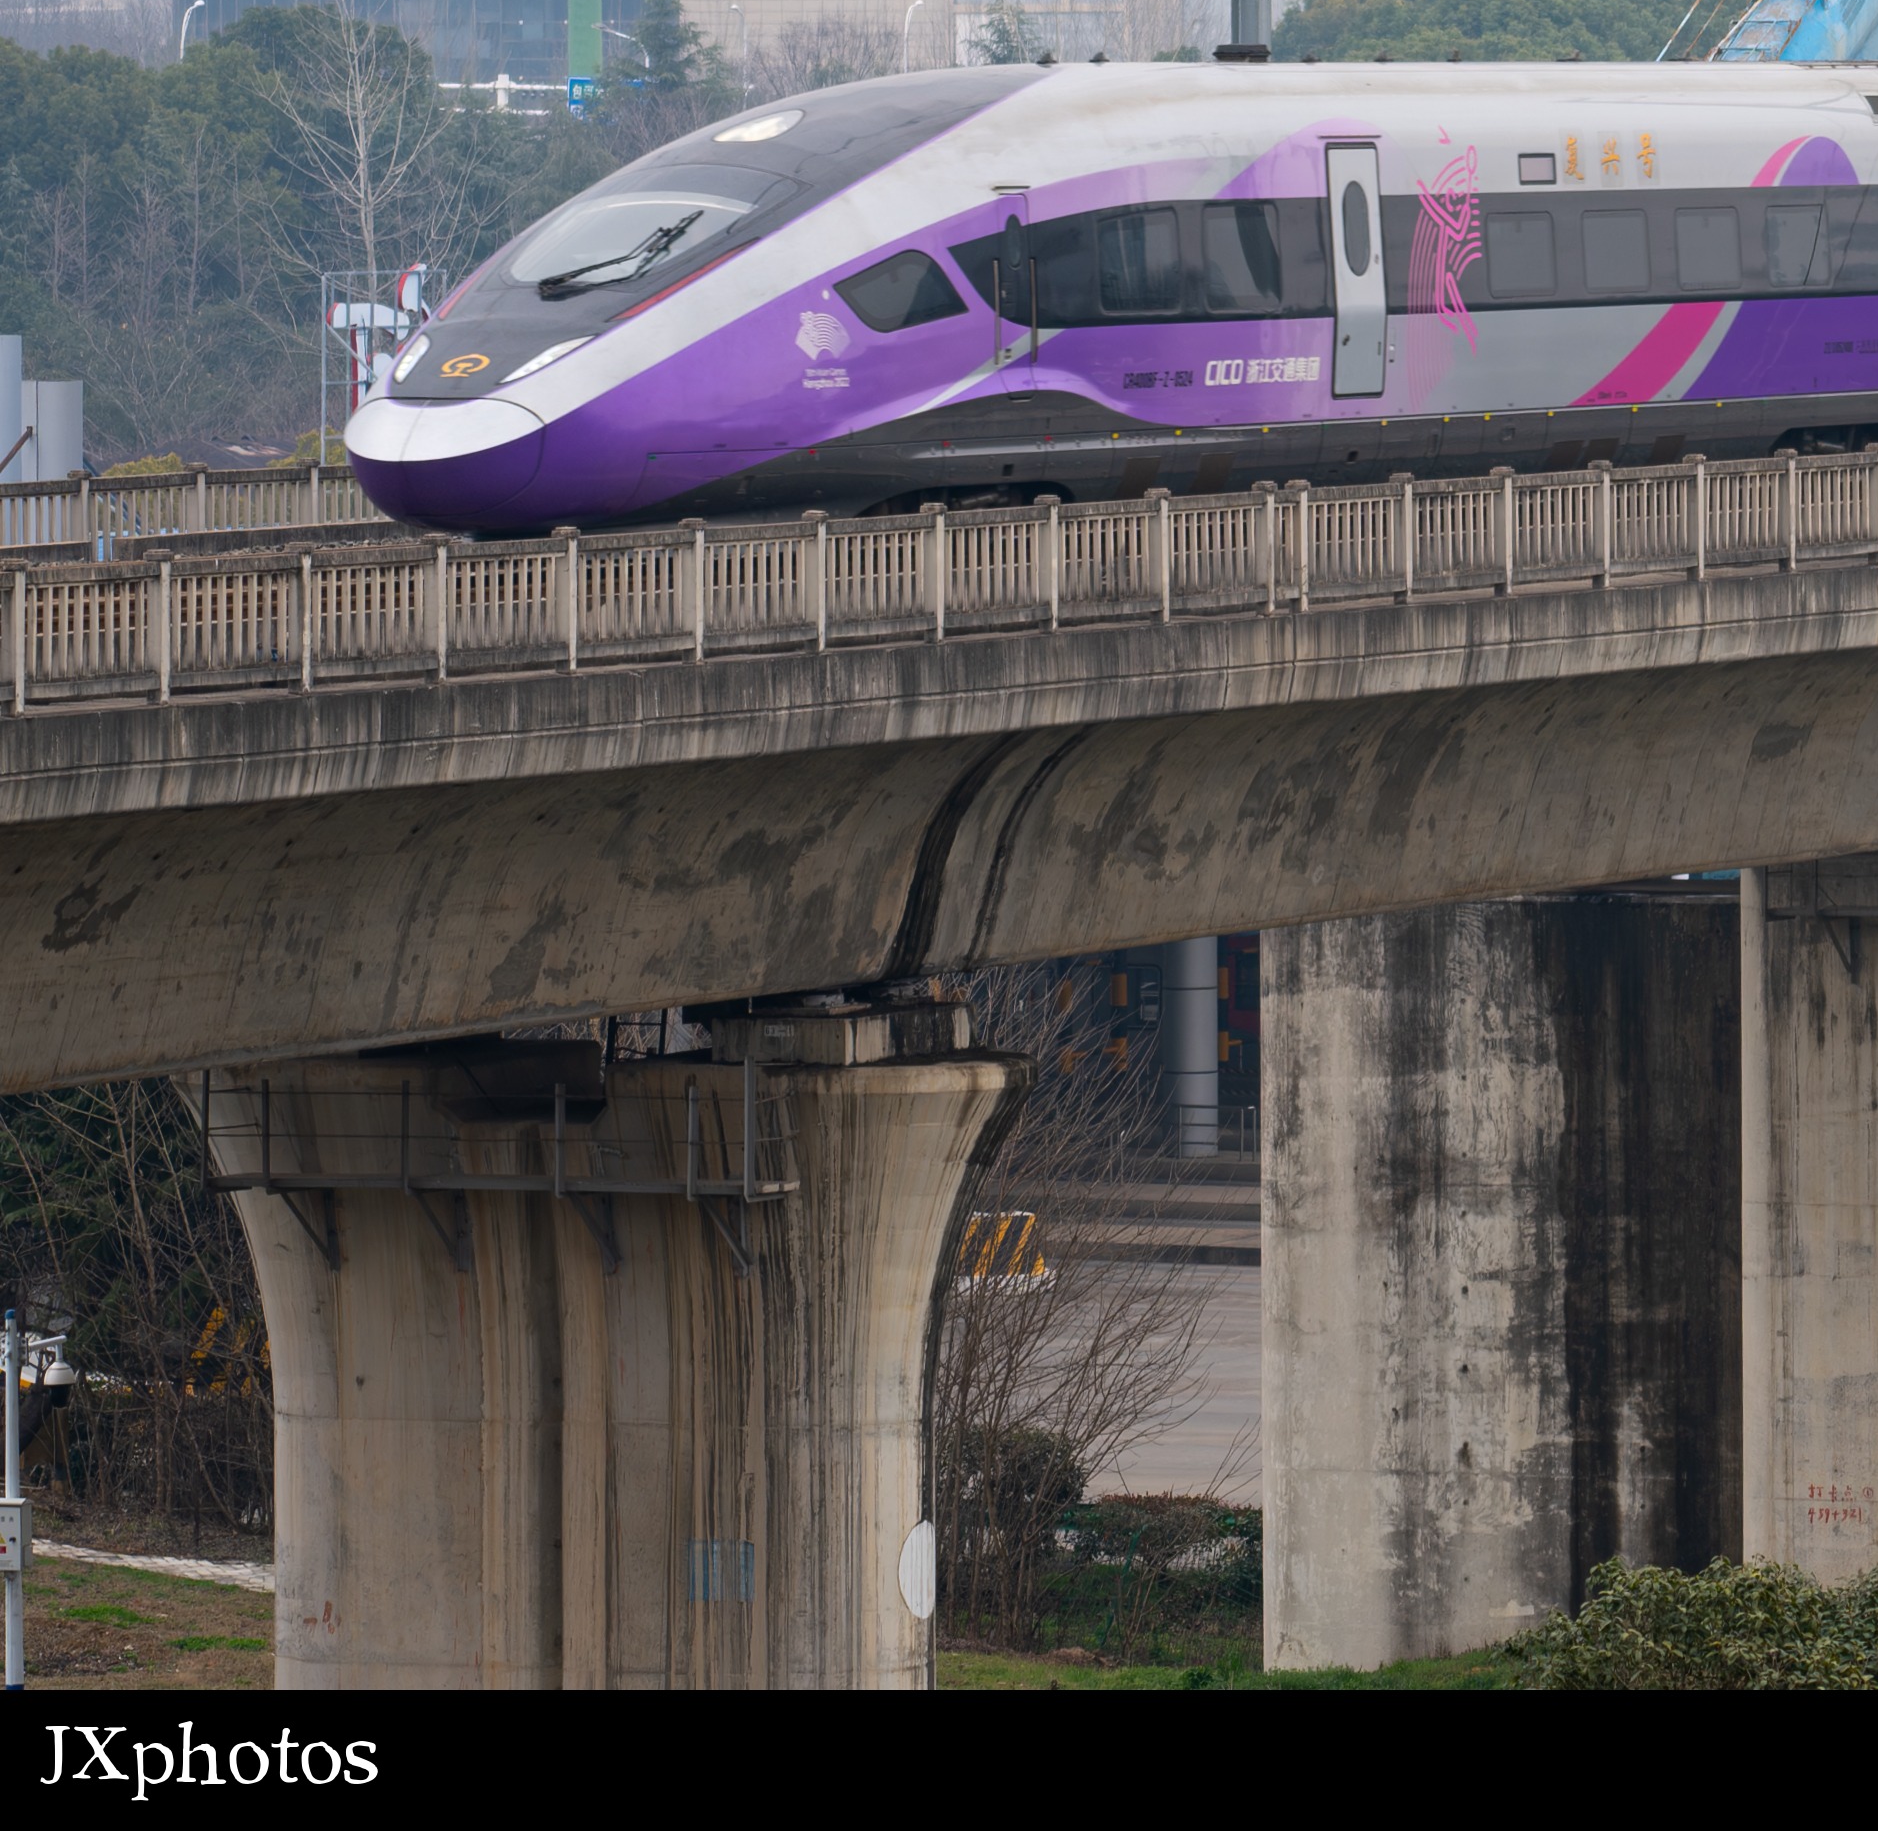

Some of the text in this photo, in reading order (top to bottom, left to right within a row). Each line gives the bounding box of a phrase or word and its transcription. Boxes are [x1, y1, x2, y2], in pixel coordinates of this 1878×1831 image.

[1204, 356, 1321, 386] CICO 浙江交通集团
